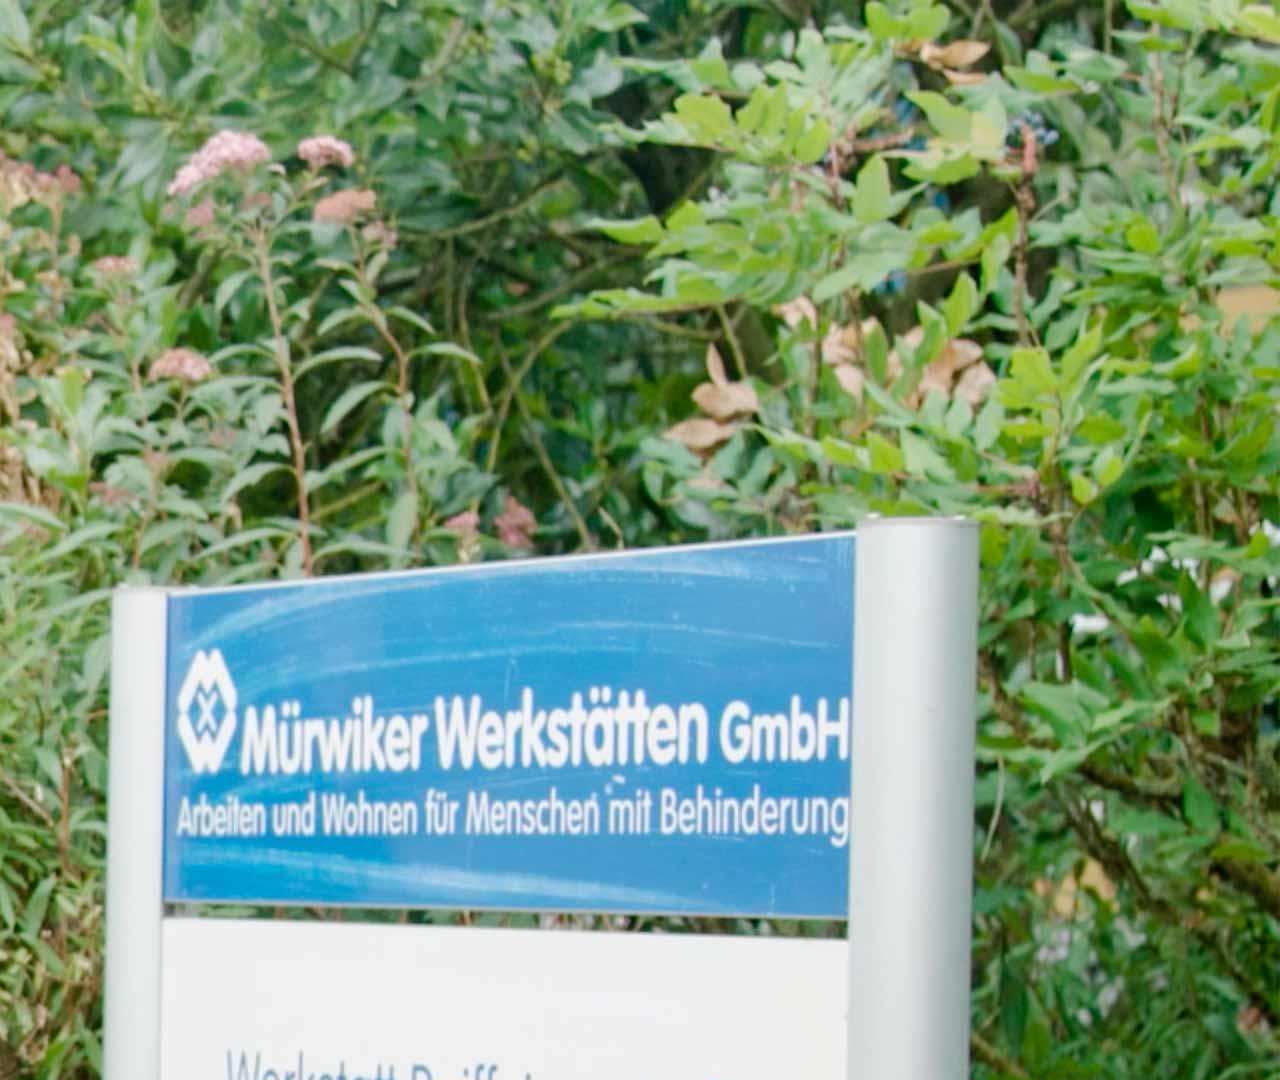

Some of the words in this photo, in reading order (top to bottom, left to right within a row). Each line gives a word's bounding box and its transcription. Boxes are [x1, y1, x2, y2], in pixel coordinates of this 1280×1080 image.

[241, 696, 428, 774] Mürwiker
[434, 686, 707, 770] Werkstätten
[719, 693, 851, 764] GmbH
[177, 792, 266, 837] Arbeiten
[272, 790, 316, 837] und
[321, 788, 418, 837] Wohnen
[425, 786, 459, 836] für
[466, 786, 599, 836] Menschen
[610, 786, 652, 834] mit
[661, 783, 851, 848] Behinderung
